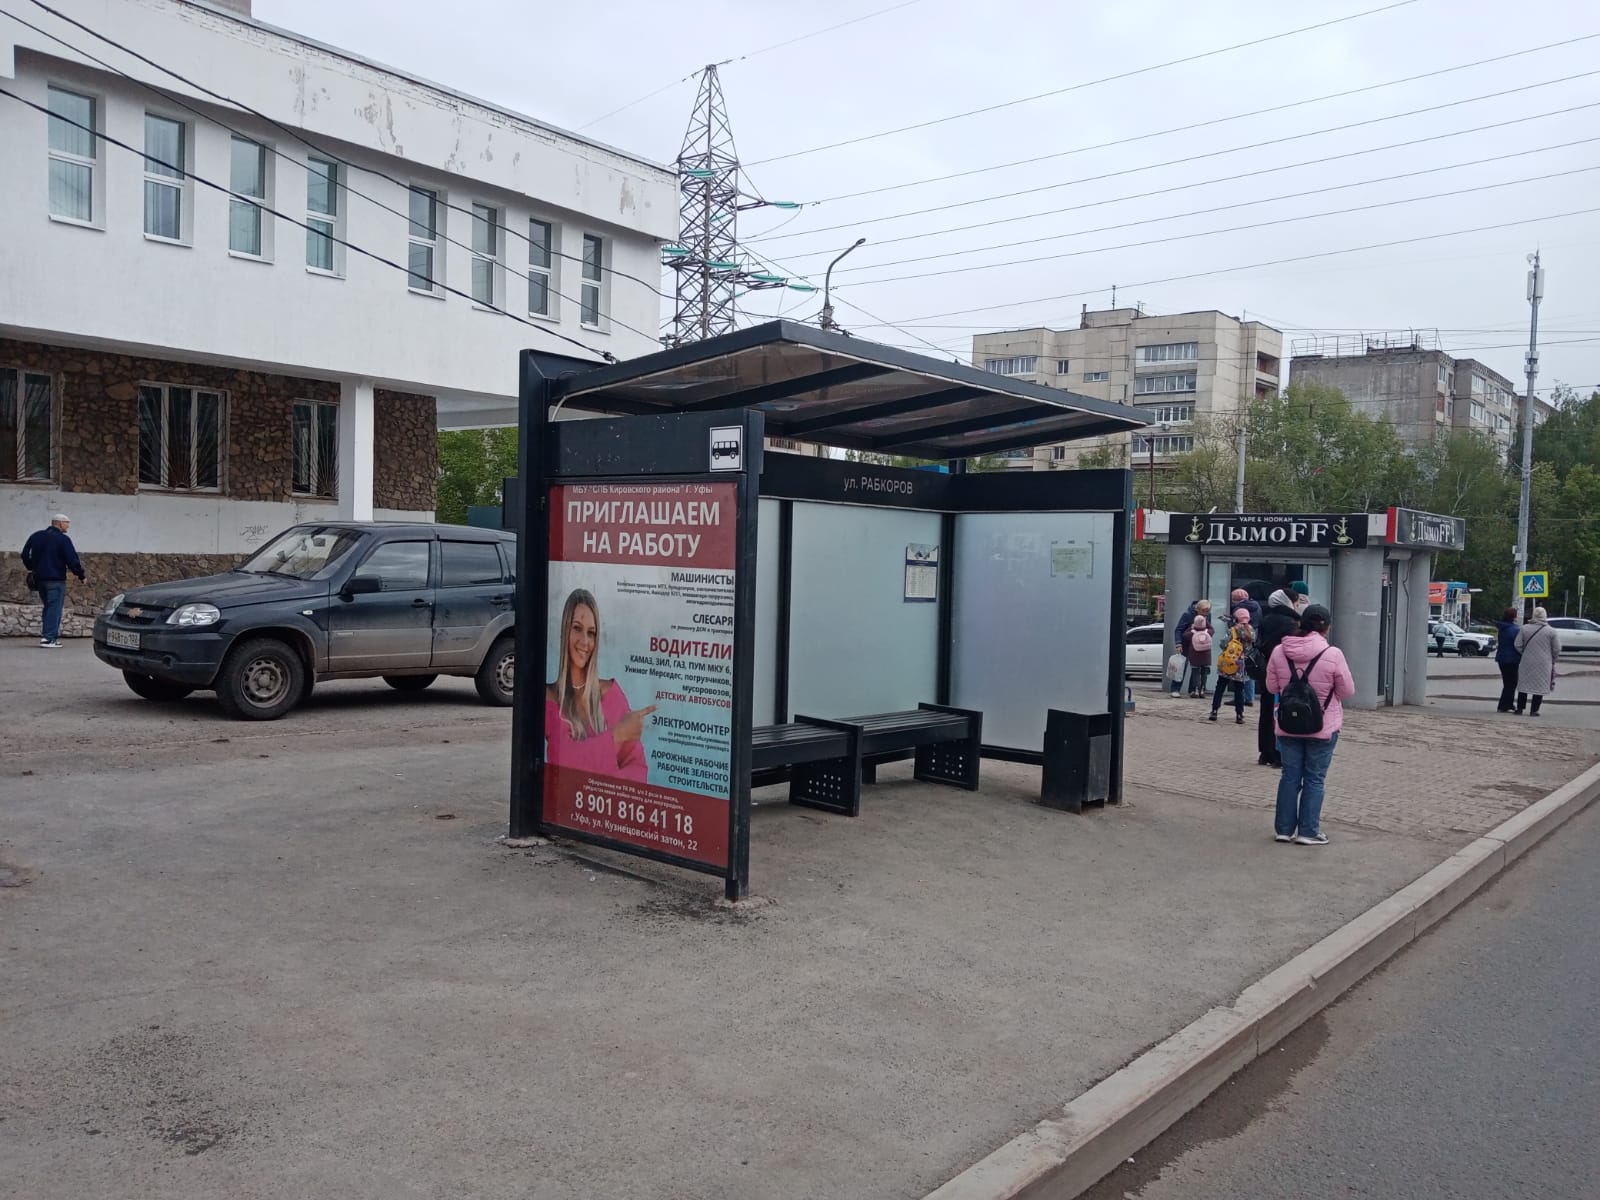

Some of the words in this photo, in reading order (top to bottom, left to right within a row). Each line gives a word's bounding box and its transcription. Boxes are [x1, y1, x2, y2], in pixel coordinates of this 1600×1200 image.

[609, 485, 651, 495] Кировского
[693, 485, 713, 496] Уфы
[843, 477, 858, 492] ул.
[861, 476, 914, 495] РАБКОРОВ
[567, 501, 720, 526] ПРИГЛАШАЕМ
[583, 531, 612, 555] НА
[618, 532, 701, 559] РАБОТУ
[671, 572, 735, 586] МАШИНИСТЫ
[692, 613, 734, 627] СЛЕСАРЯ
[649, 636, 733, 661] ВОДИТЕЛИ
[624, 665, 648, 675] Унимог
[649, 667, 683, 681] Мерседес,
[684, 673, 732, 687] погрузчиков,
[630, 655, 654, 666] КАМАЗ,
[655, 656, 672, 669] ЗИЛ,
[673, 658, 687, 670] ГАЗ,
[688, 660, 706, 672] ПУМ
[707, 662, 724, 674] МКУ
[725, 665, 732, 676] 6,
[656, 690, 687, 703] ДЕТСКИХ
[688, 695, 731, 709] АВТОБУСОВ
[682, 685, 732, 699] мусоровозов,
[651, 715, 730, 737] ЭЛЕКТРОМОНТЕР
[651, 750, 693, 765] ДОРОЖНЫЕ
[694, 757, 729, 771] РАБОЧИЕ
[657, 762, 690, 776] РАБОЧИЕ
[691, 768, 729, 783] ЗЕЛЕНОГО
[668, 775, 729, 795] СТРОИТЕЛЬСТВА
[575, 791, 584, 809] 8
[587, 794, 613, 816] 901
[617, 800, 645, 824] 816
[649, 808, 667, 829] 41
[674, 813, 693, 835] 18
[592, 817, 603, 829] ул.
[604, 819, 659, 841] Кузнецовский
[660, 835, 686, 850] затон,
[687, 839, 698, 852] 22
